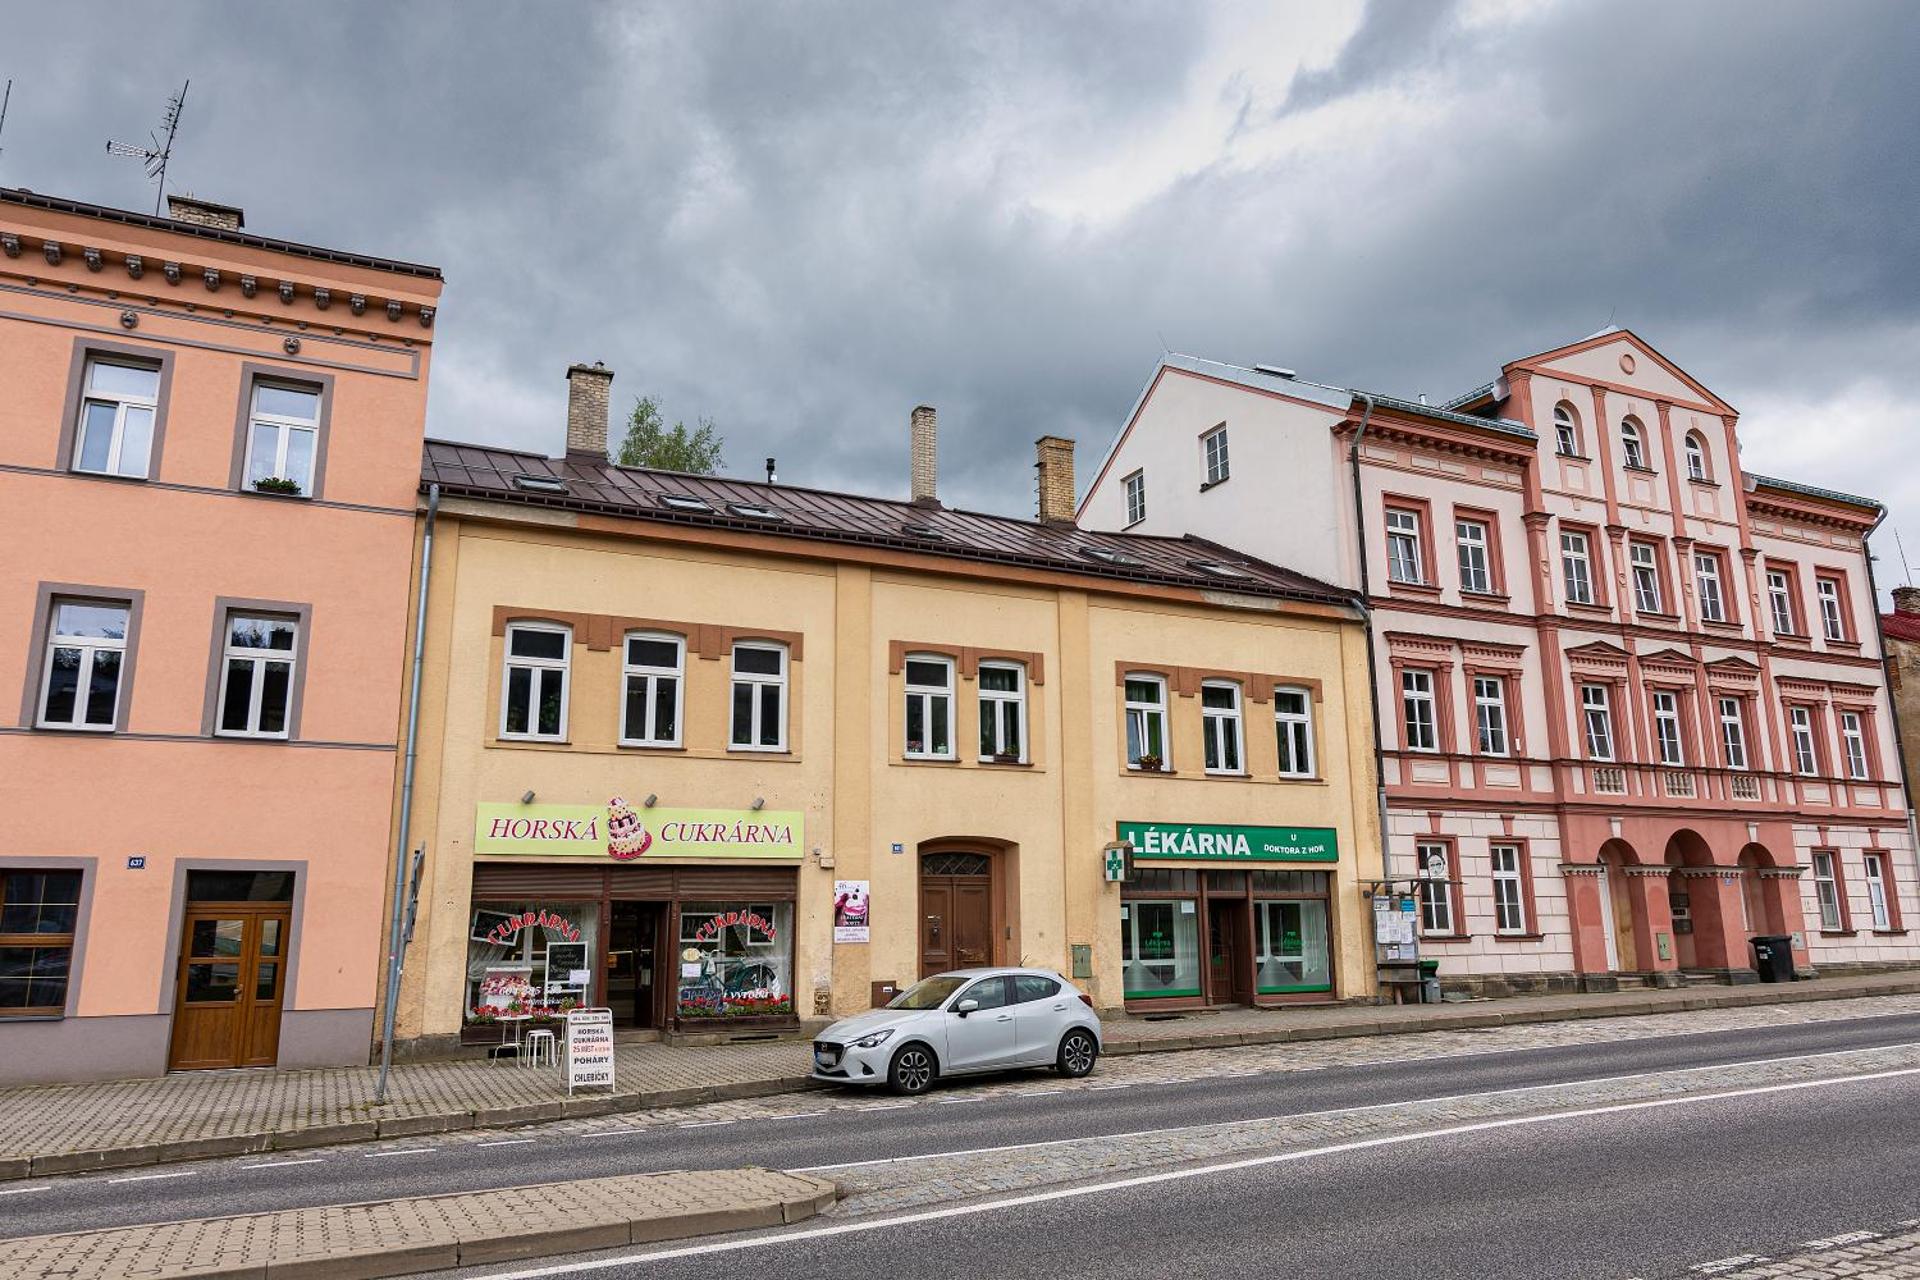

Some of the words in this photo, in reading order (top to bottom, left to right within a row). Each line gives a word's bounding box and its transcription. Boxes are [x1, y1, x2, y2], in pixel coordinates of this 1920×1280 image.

[488, 816, 599, 840] HORSKÁ
[661, 819, 793, 843] CUKRÁRNA
[1128, 827, 1252, 855] LÉKÁRNA
[1290, 833, 1297, 841] U
[1263, 844, 1300, 855] DOKTORA
[1301, 847, 1308, 855] Z
[1308, 845, 1325, 854] HOR
[487, 908, 581, 944] CUKRÁRNA
[695, 908, 777, 942] CUKRÁRNA
[577, 1027, 605, 1035] HORSKÁ
[573, 1036, 609, 1044] CUKRÁRNA
[574, 1055, 609, 1064] POHÁRY
[574, 1070, 609, 1083] CHLEBÍČKY
